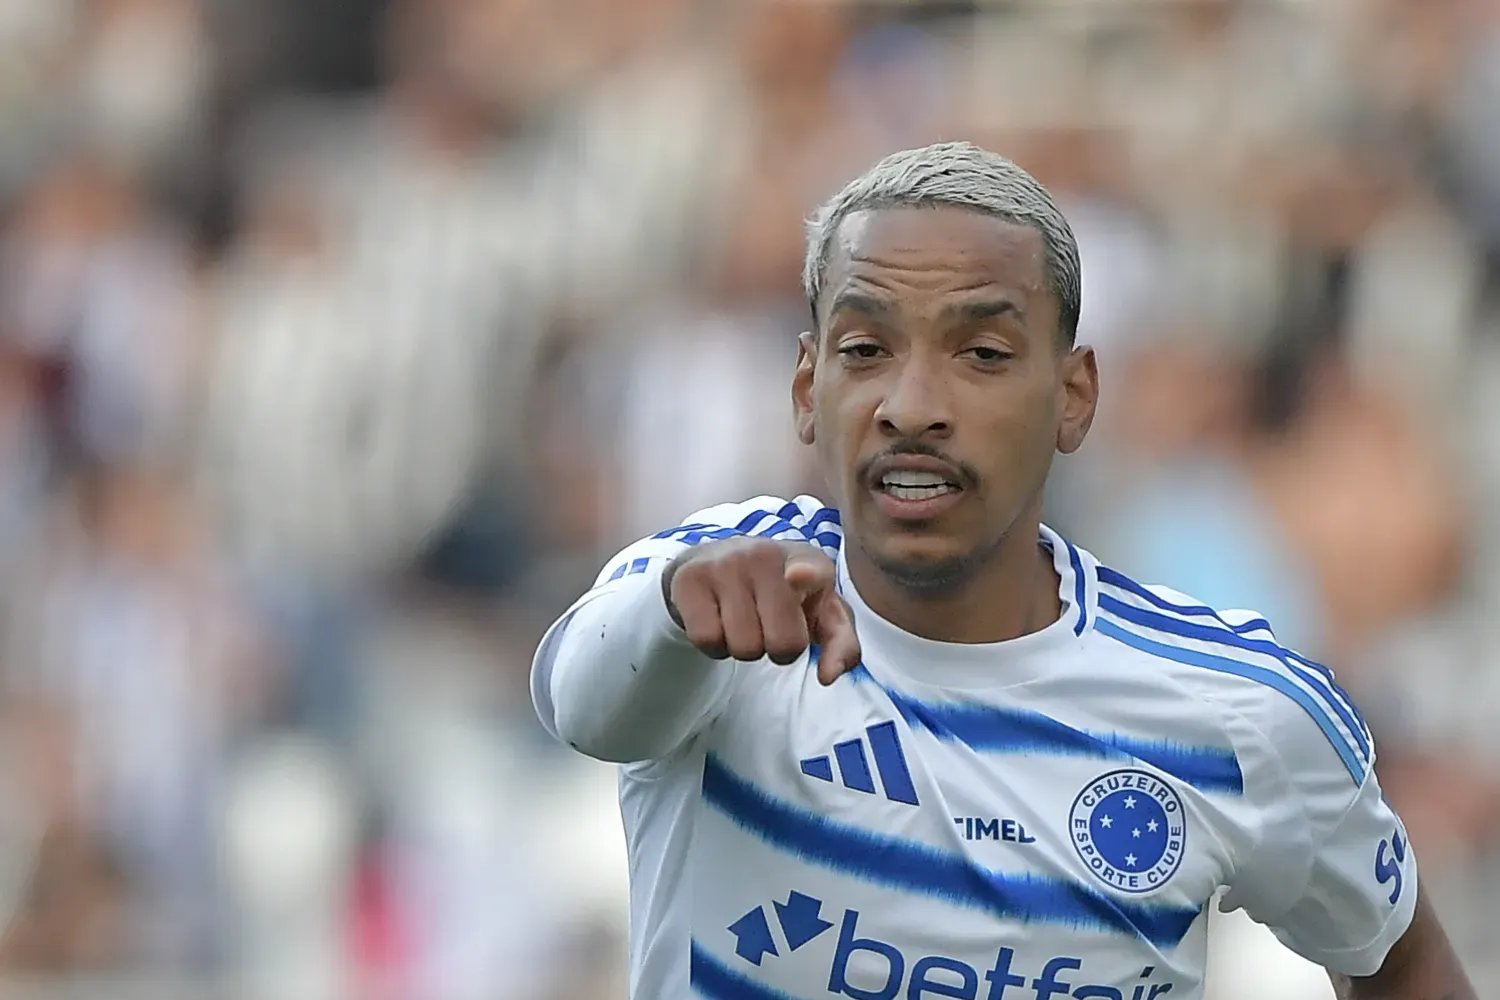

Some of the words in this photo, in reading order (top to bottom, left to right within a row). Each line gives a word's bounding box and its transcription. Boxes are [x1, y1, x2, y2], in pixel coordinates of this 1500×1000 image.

[1082, 775, 1177, 813] CRUZEIRO
[1074, 818, 1139, 888] ESPORTE
[1147, 826, 1181, 884] CLUBE
